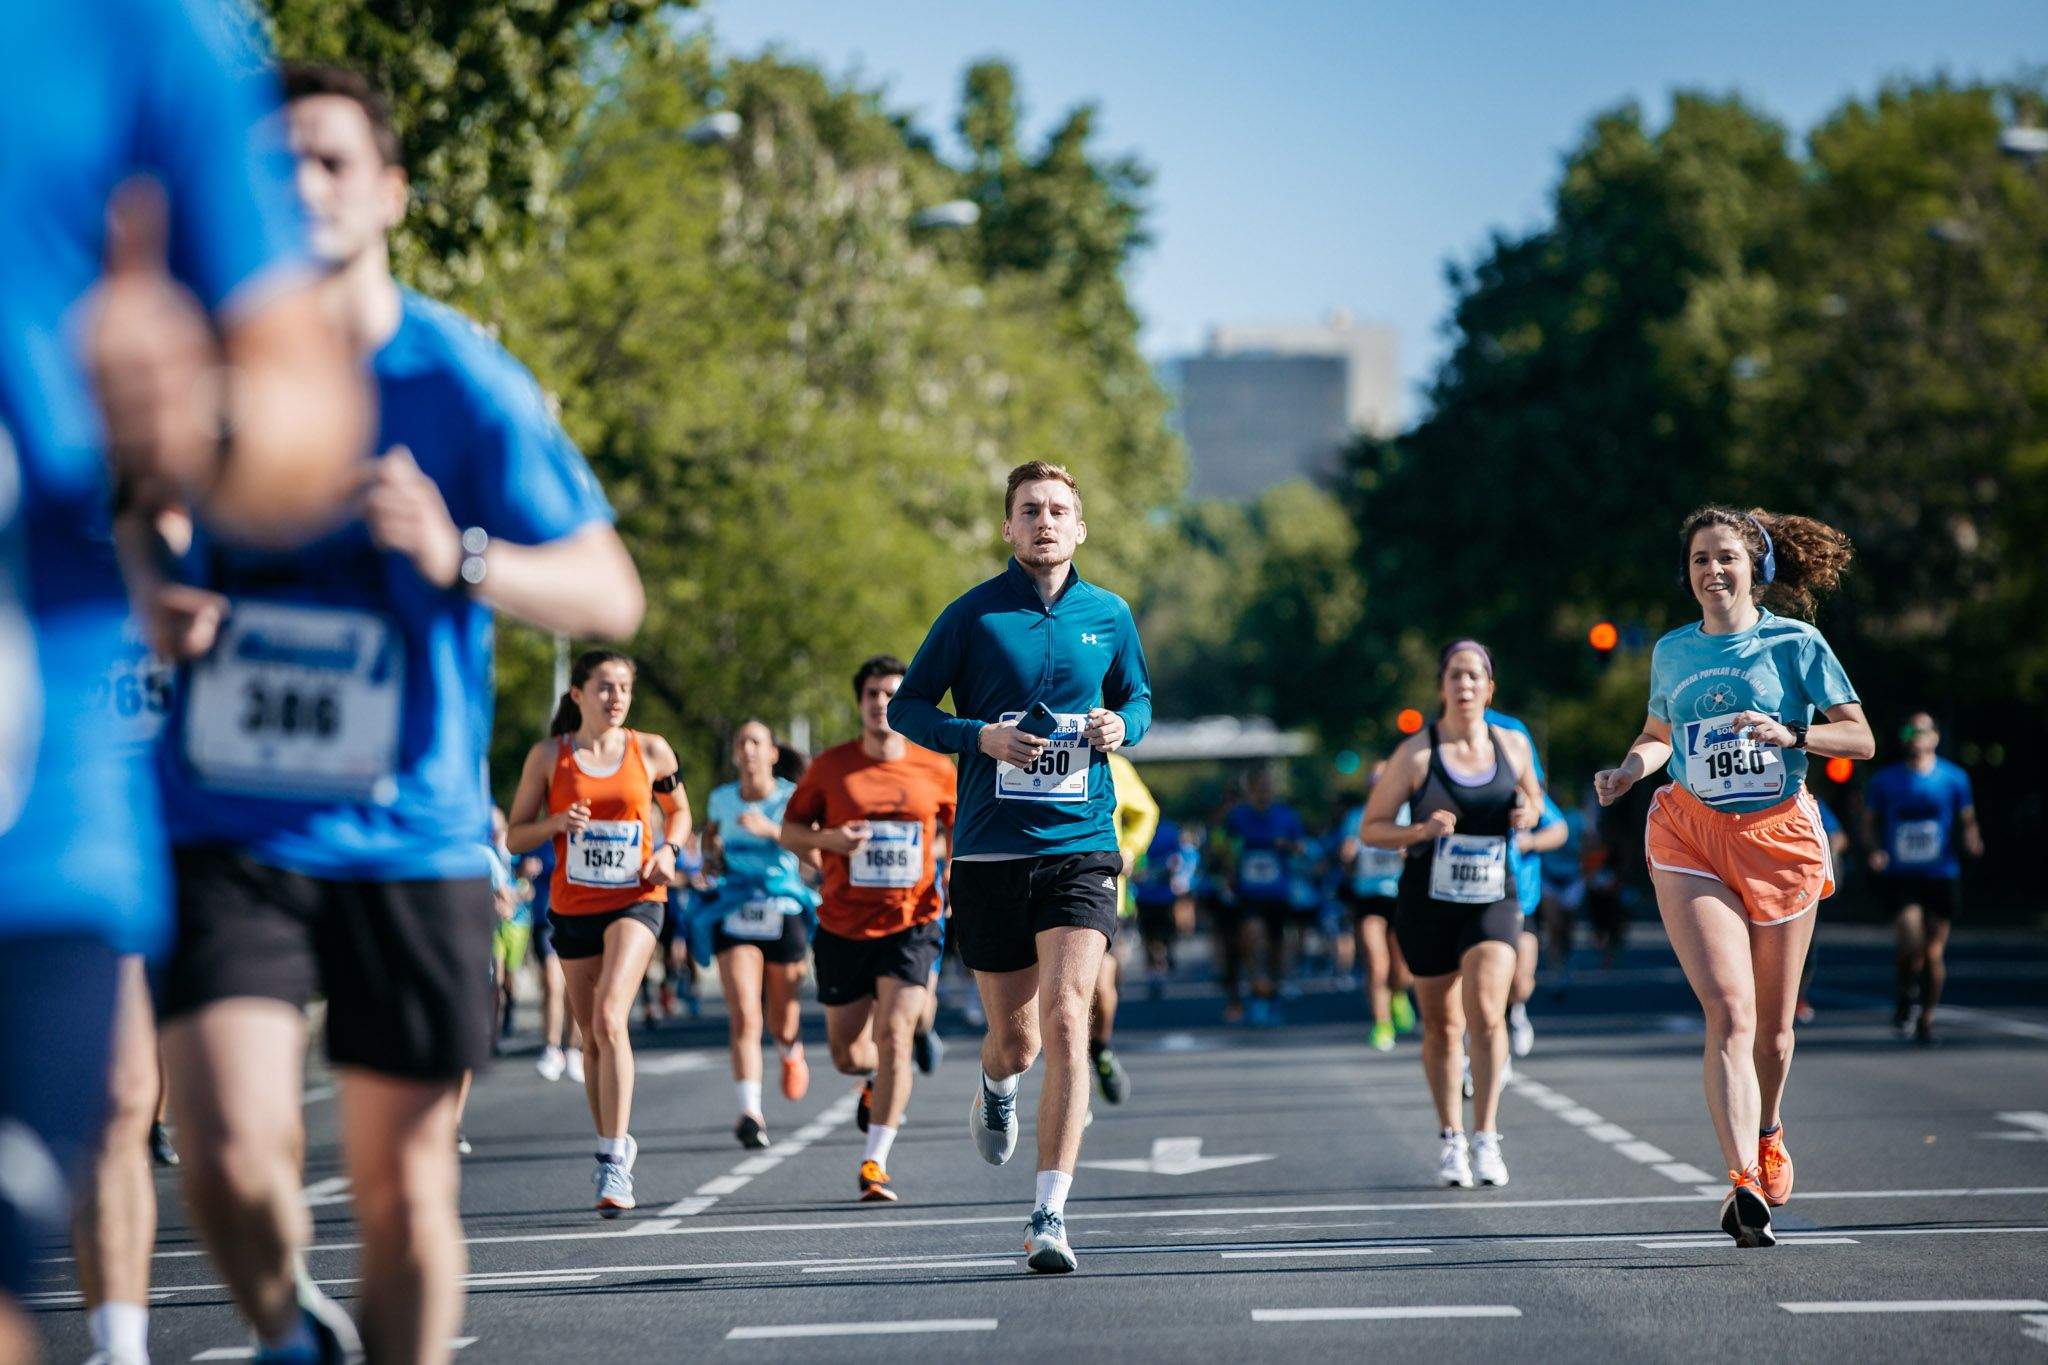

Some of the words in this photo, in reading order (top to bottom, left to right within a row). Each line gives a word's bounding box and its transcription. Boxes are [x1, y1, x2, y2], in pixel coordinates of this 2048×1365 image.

[1700, 667, 1730, 679] POPULAR
[1705, 749, 1765, 779] 1930
[584, 849, 625, 867] 1542
